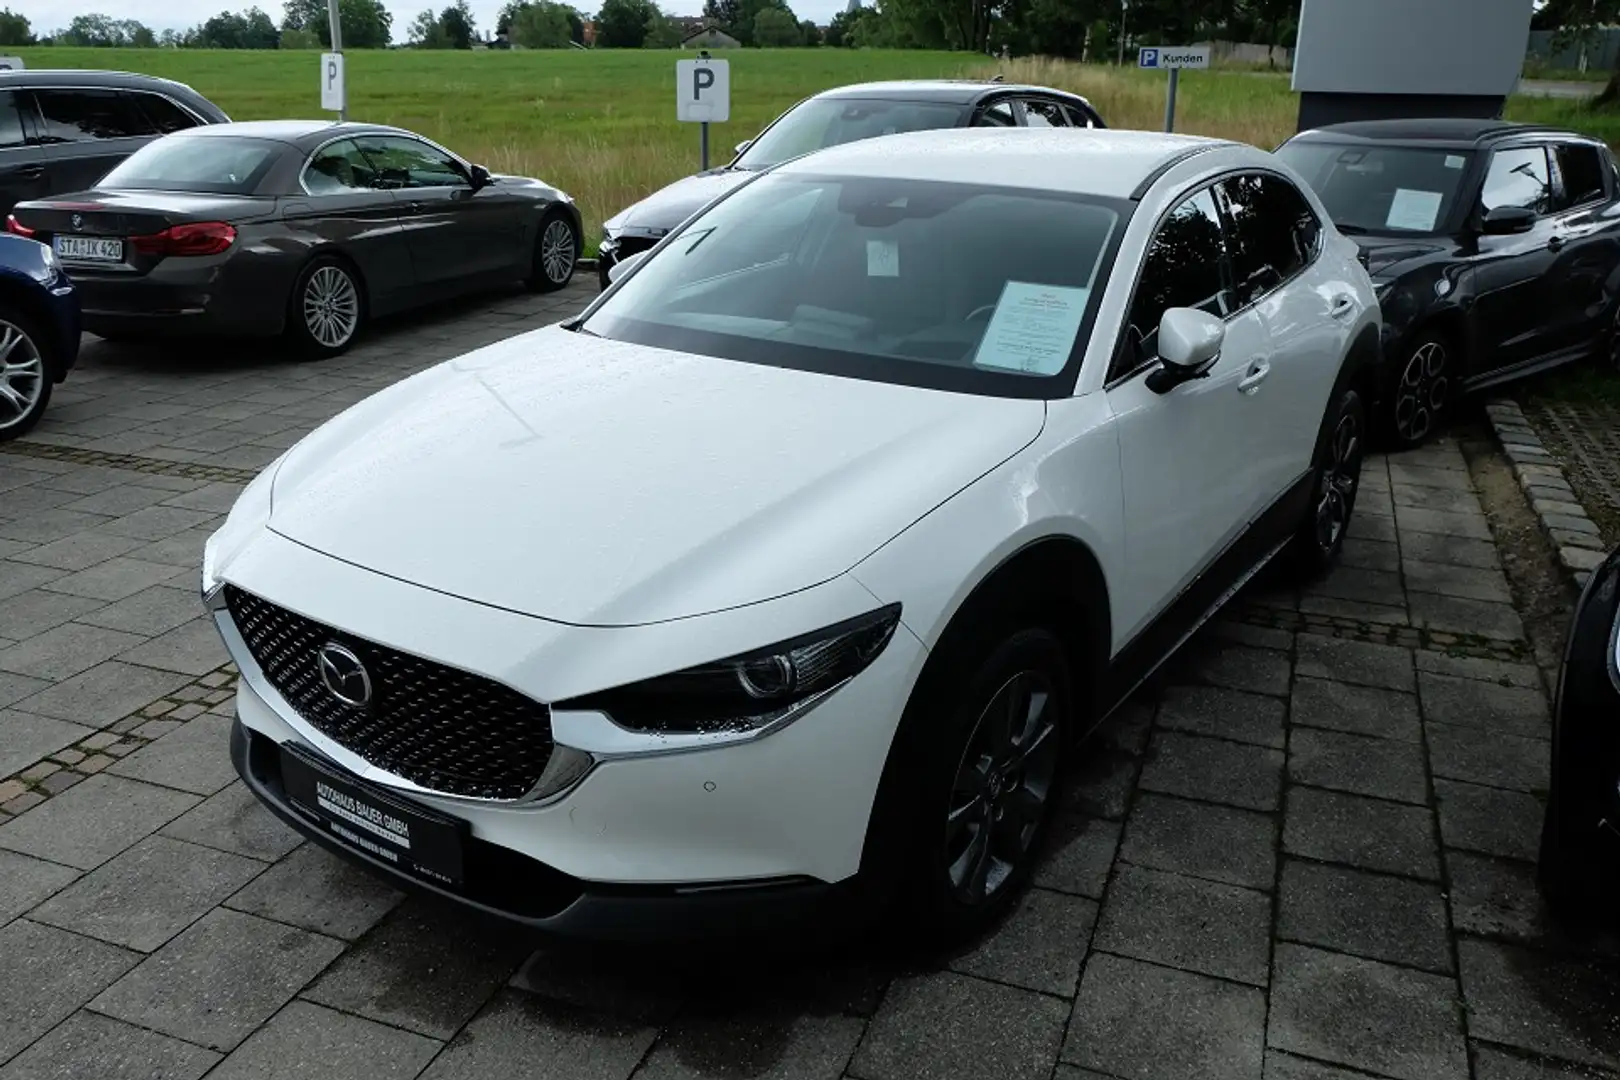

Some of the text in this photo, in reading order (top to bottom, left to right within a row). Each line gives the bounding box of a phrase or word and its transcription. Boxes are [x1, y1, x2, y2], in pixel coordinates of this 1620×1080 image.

[1143, 51, 1203, 65] P Kunden
[328, 61, 337, 91] P
[694, 68, 715, 101] P
[60, 239, 79, 254] STA
[101, 241, 121, 257] 420
[316, 781, 356, 812] AUTOHAUS
[356, 801, 384, 826] BAUER
[384, 814, 410, 837] GMBH
